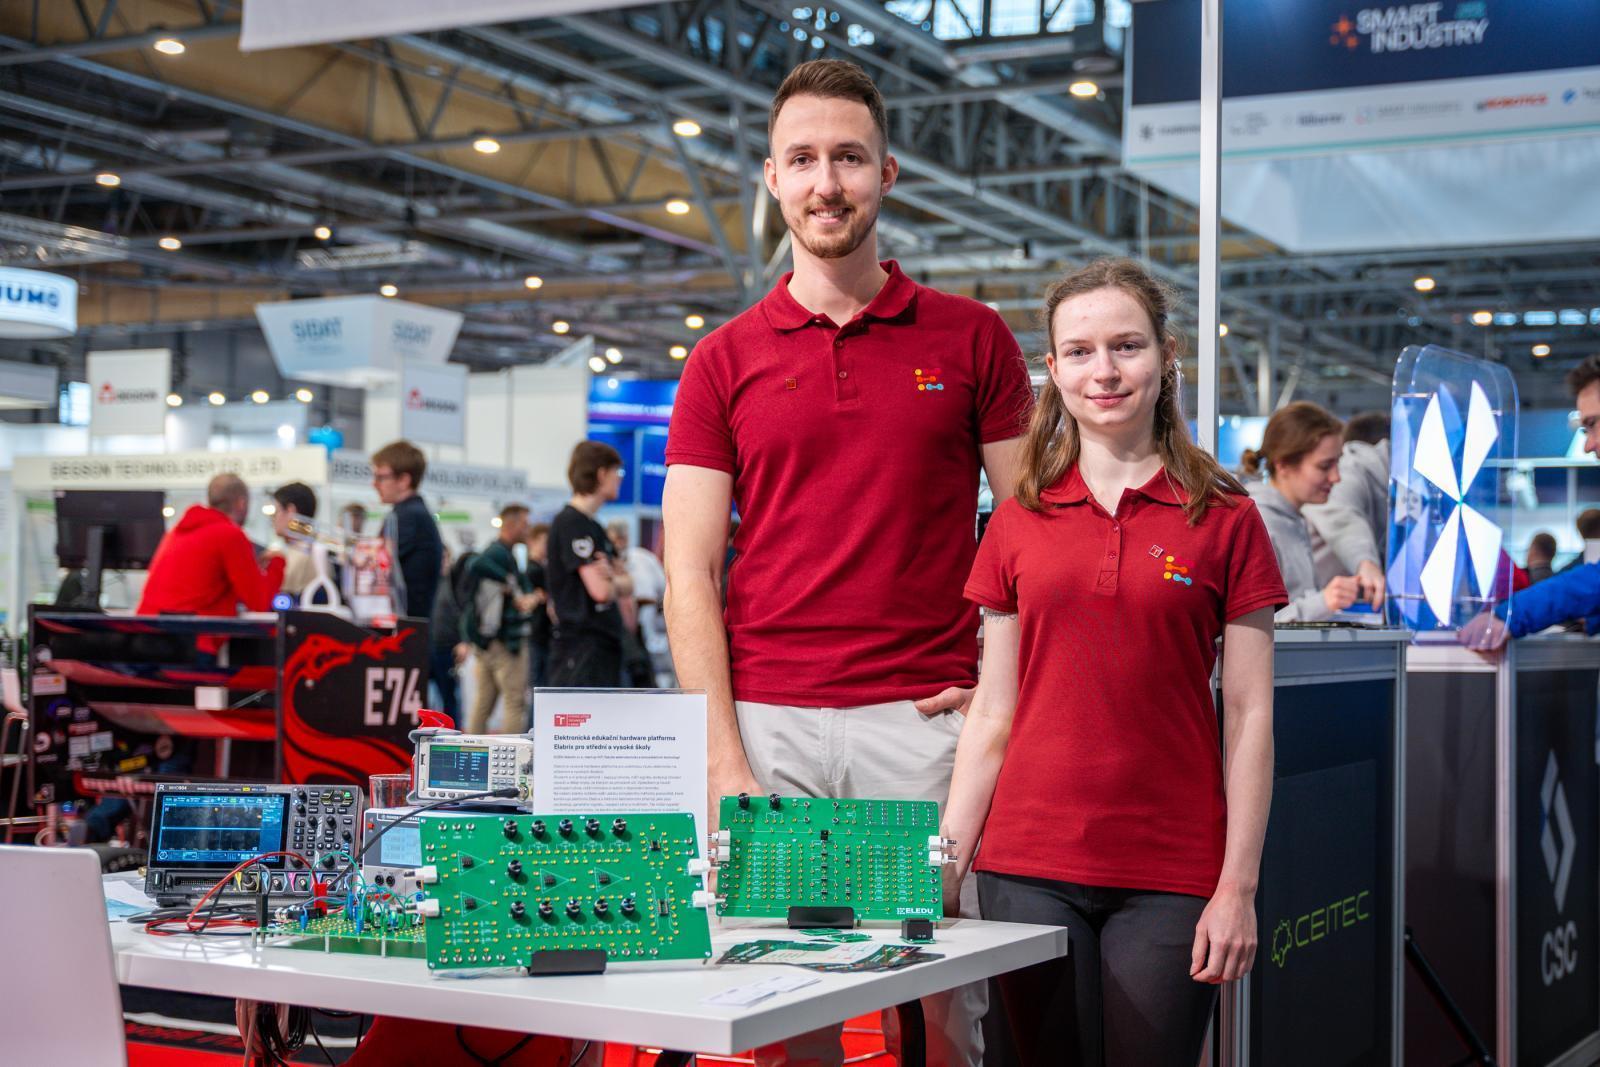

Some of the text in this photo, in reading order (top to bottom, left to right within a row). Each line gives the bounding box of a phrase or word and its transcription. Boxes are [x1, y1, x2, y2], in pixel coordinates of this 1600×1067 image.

[1356, 2, 1443, 34] SMART
[1371, 18, 1489, 53] INDUSTRY
[364, 667, 423, 726] E74
[1296, 890, 1369, 947] CEITEC
[1541, 920, 1578, 987] CSC
